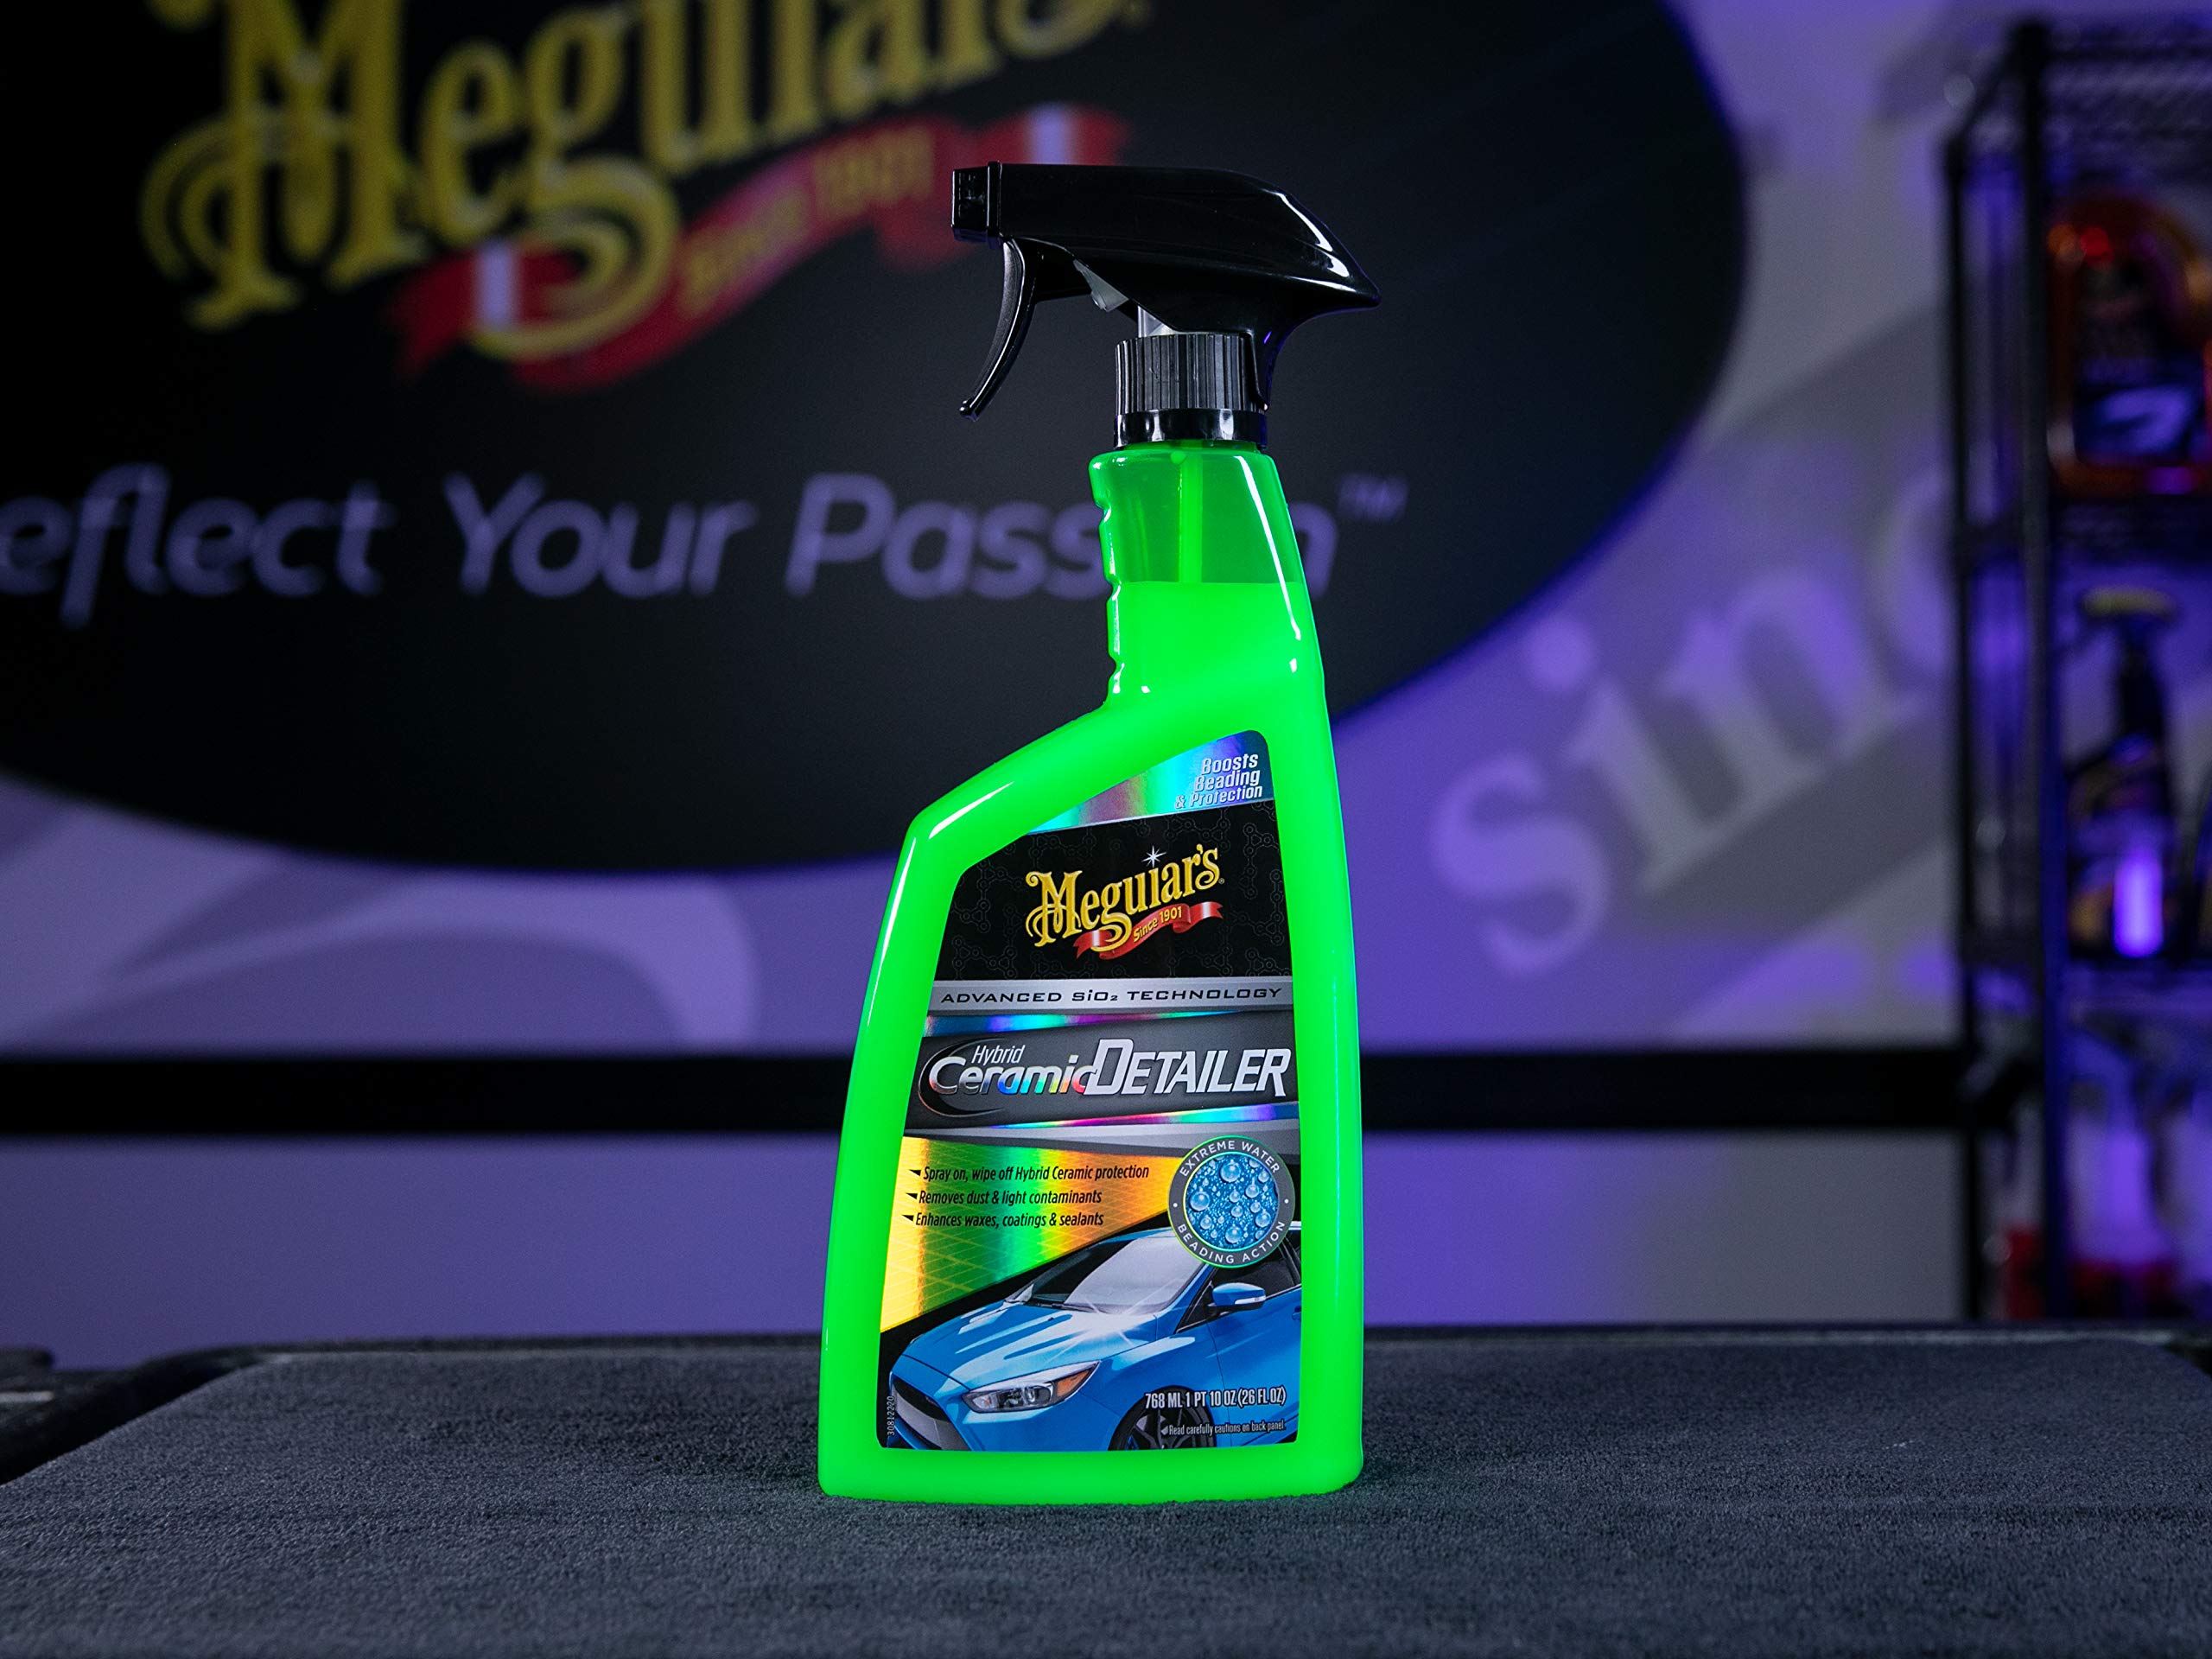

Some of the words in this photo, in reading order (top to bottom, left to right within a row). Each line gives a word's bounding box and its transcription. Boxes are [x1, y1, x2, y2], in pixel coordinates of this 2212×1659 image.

[0, 461, 399, 627] eflect
[444, 472, 757, 599] Your
[785, 472, 1339, 600] Passn
[1201, 753, 1259, 775] Boosts
[1194, 770, 1261, 792] Beading
[1175, 794, 1186, 810] &
[1190, 785, 1263, 807] Protection
[1025, 843, 1221, 952] Meguiar's
[1133, 918, 1159, 943] Since
[1160, 906, 1183, 925] 1901
[940, 993, 1062, 1003] ADVANCED
[1127, 988, 1282, 1001] TECHNOLOGY
[971, 1045, 1026, 1066] Hybrid
[928, 1050, 1096, 1095] Ceramic
[1083, 1038, 1292, 1097] DETAILER
[1179, 1140, 1236, 1177] EXTREME
[1242, 1141, 1281, 1173] WATER
[923, 1166, 951, 1182] Spray
[953, 1169, 969, 1182] on,
[972, 1166, 996, 1183] wipe
[998, 1166, 1014, 1180] off
[1014, 1166, 1051, 1182] Hybrid
[1052, 1165, 1093, 1180] Ceramic
[1095, 1164, 1150, 1181] protection
[918, 1190, 964, 1205] Removes
[966, 1191, 989, 1205] dust
[991, 1190, 1000, 1205] &
[1001, 1190, 1027, 1207] light
[1029, 1189, 1103, 1205] contaminants
[916, 1212, 962, 1226] Enhances
[964, 1215, 1000, 1229] waxes,
[1002, 1212, 1047, 1229] coatings
[1048, 1211, 1058, 1226] &
[1059, 1211, 1104, 1226] sealants
[1178, 1224, 1235, 1264] BEADING
[1242, 1221, 1286, 1262] ACTION
[1145, 1392, 1166, 1409] 768
[1167, 1391, 1183, 1408] ML
[1185, 1391, 1192, 1408] 1
[1194, 1390, 1207, 1408] PT
[1210, 1389, 1222, 1407] 10
[1224, 1389, 1237, 1406] OZ
[1237, 1387, 1255, 1408] (26
[1257, 1388, 1268, 1404] FL
[1270, 1385, 1287, 1406] OZ)
[1168, 1423, 1185, 1435] Read
[1185, 1423, 1213, 1436] carefully
[1214, 1422, 1242, 1433] cautions
[1242, 1422, 1250, 1432] on
[1251, 1421, 1267, 1432] back
